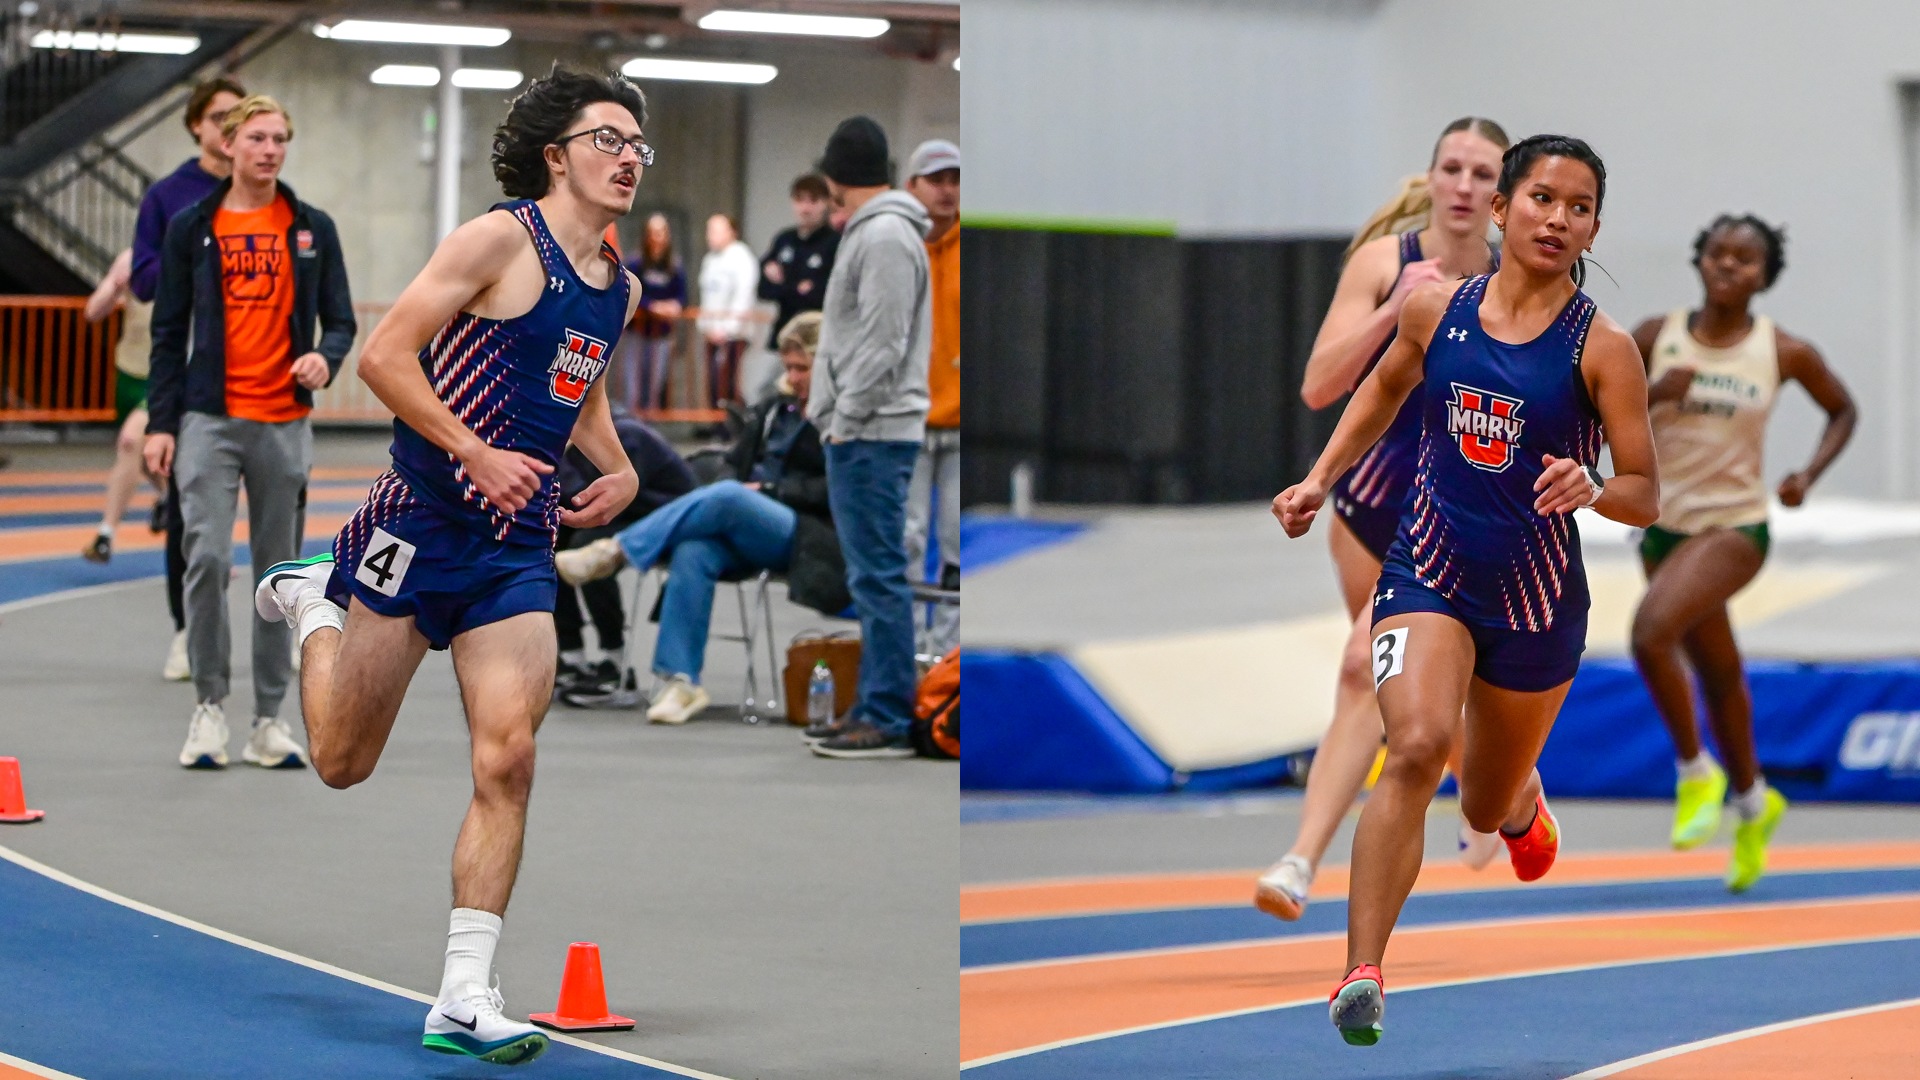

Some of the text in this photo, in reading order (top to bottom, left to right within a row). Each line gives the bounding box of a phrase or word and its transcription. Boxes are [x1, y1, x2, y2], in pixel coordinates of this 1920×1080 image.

[221, 251, 281, 274] MARY
[552, 347, 602, 383] MARY
[1450, 405, 1519, 443] MARY
[364, 542, 400, 588] 4
[1376, 633, 1396, 686] 3
